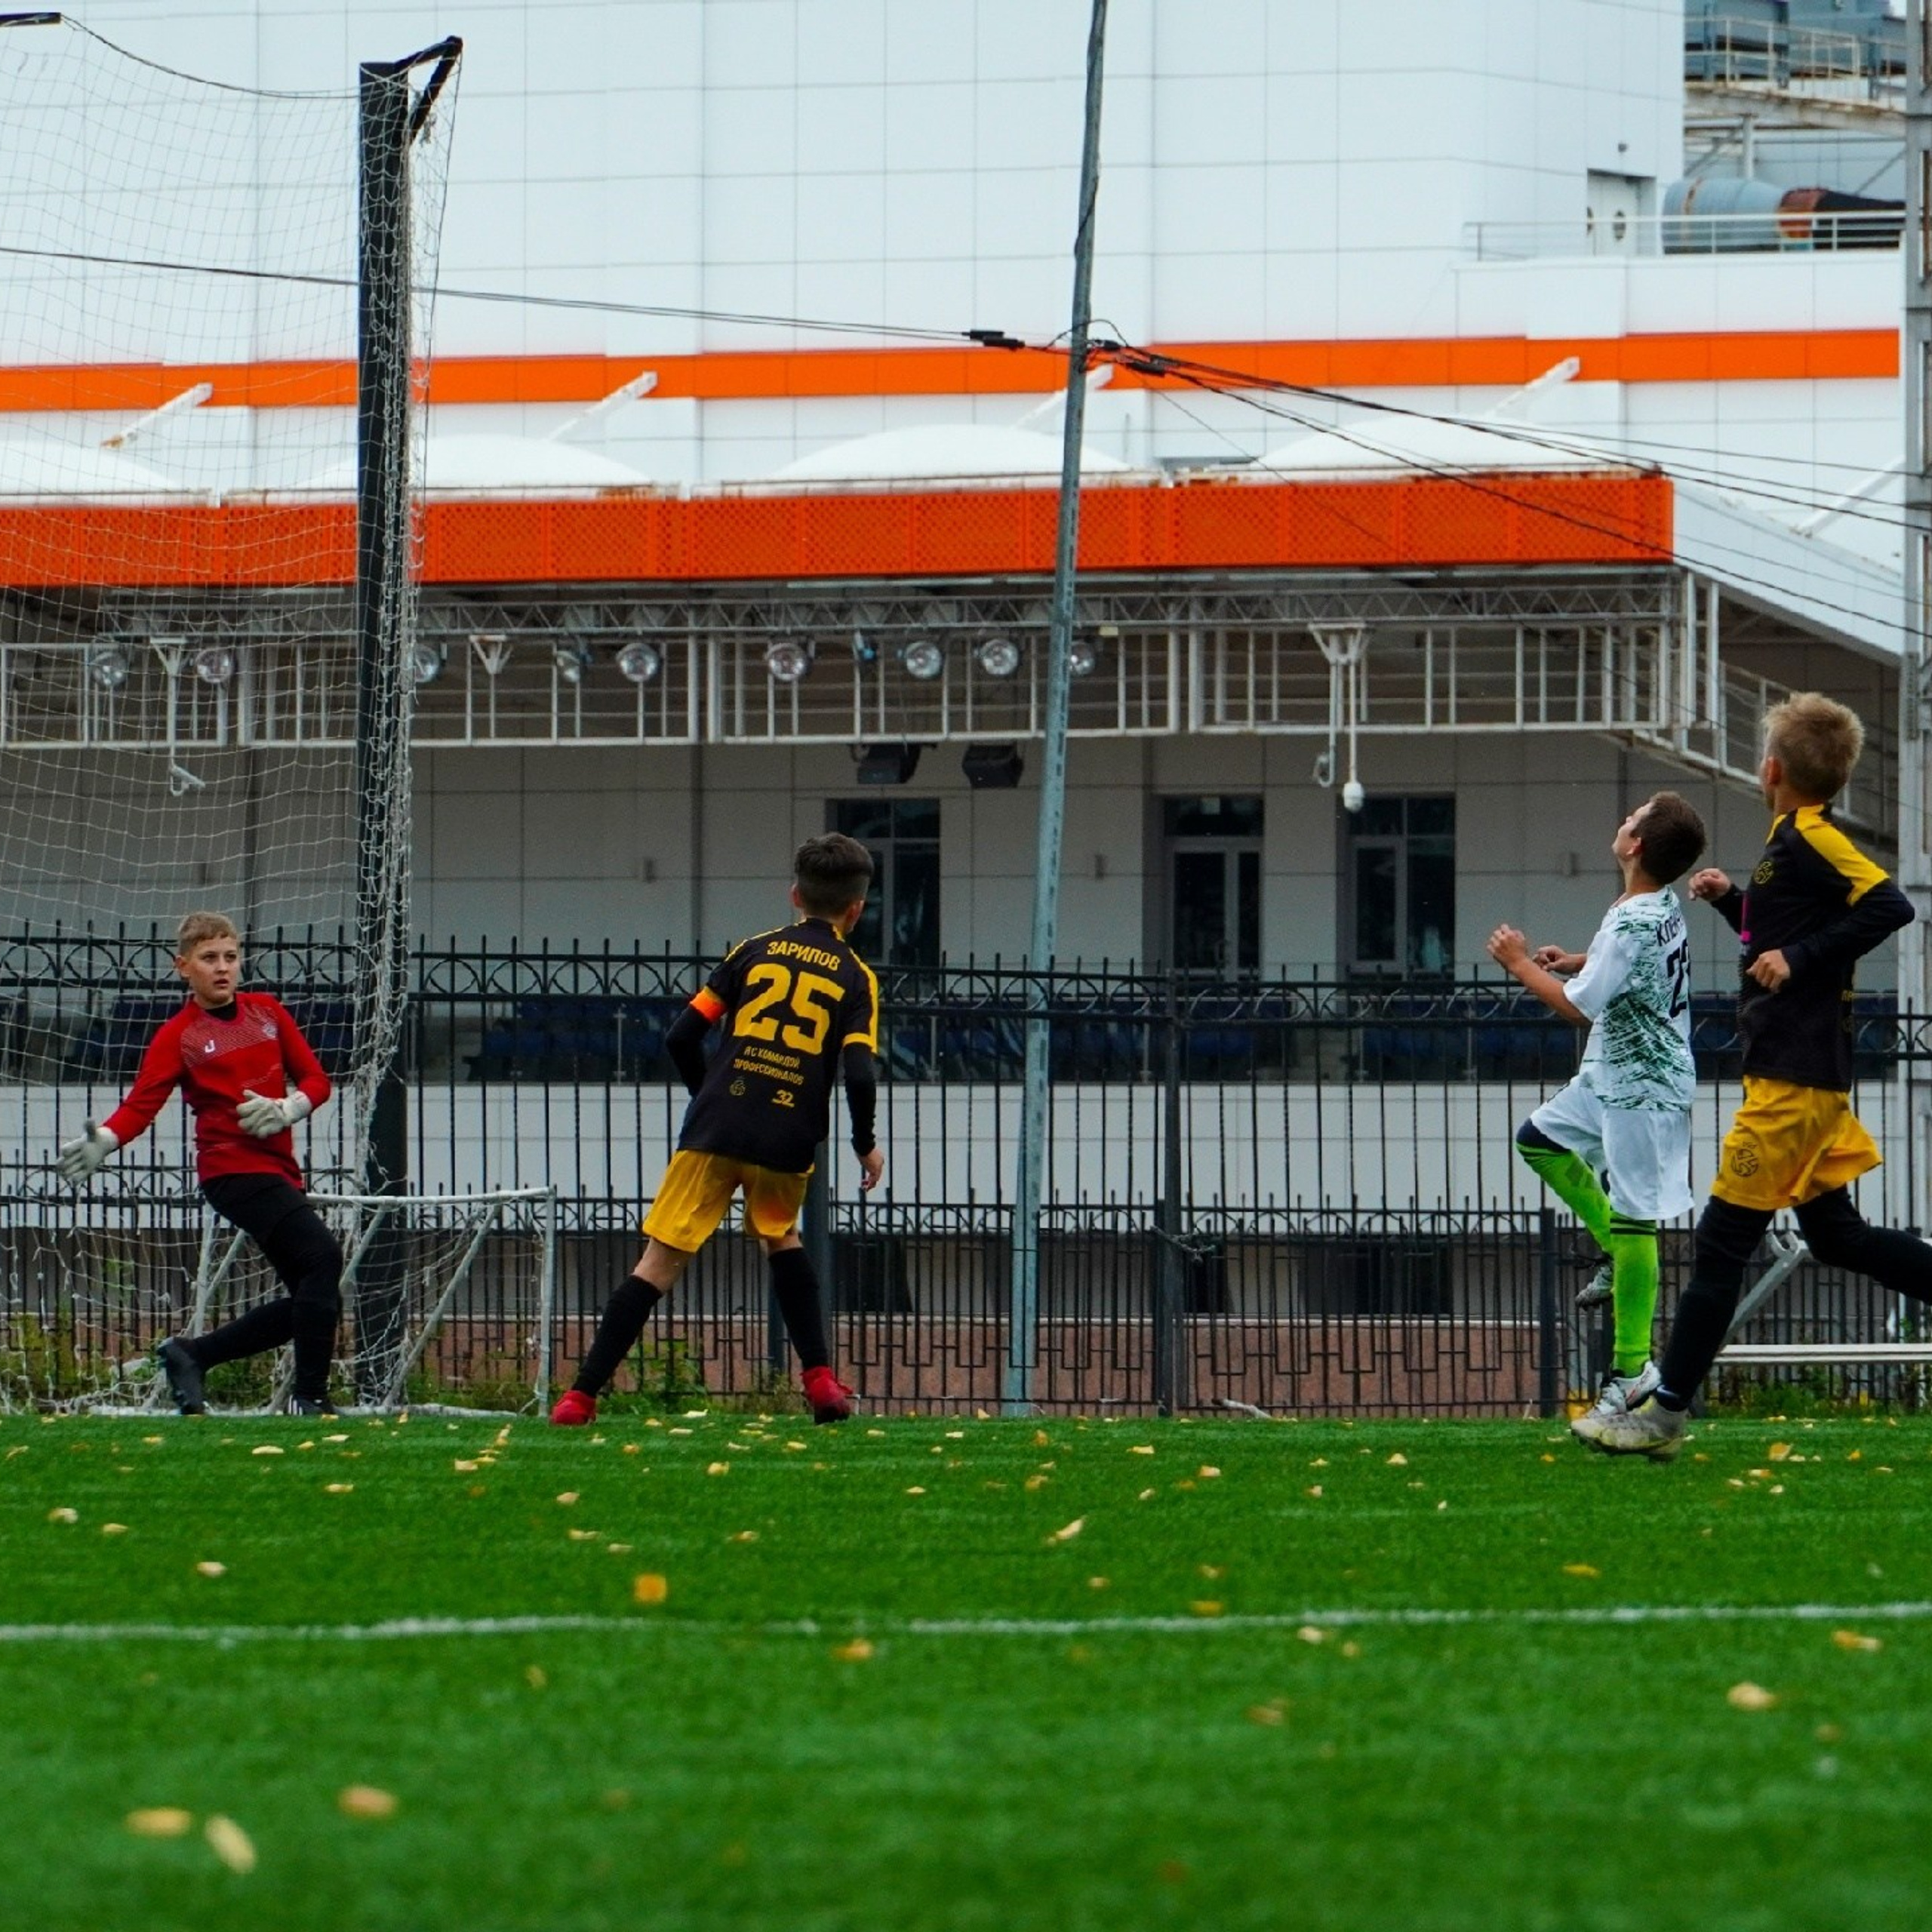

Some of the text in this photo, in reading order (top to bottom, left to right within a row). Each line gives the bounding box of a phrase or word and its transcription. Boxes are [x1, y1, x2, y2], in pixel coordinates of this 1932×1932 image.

[767, 941, 841, 971] ЗАРИПОВ
[733, 963, 845, 1054] 25
[772, 1089, 795, 1108] 32
